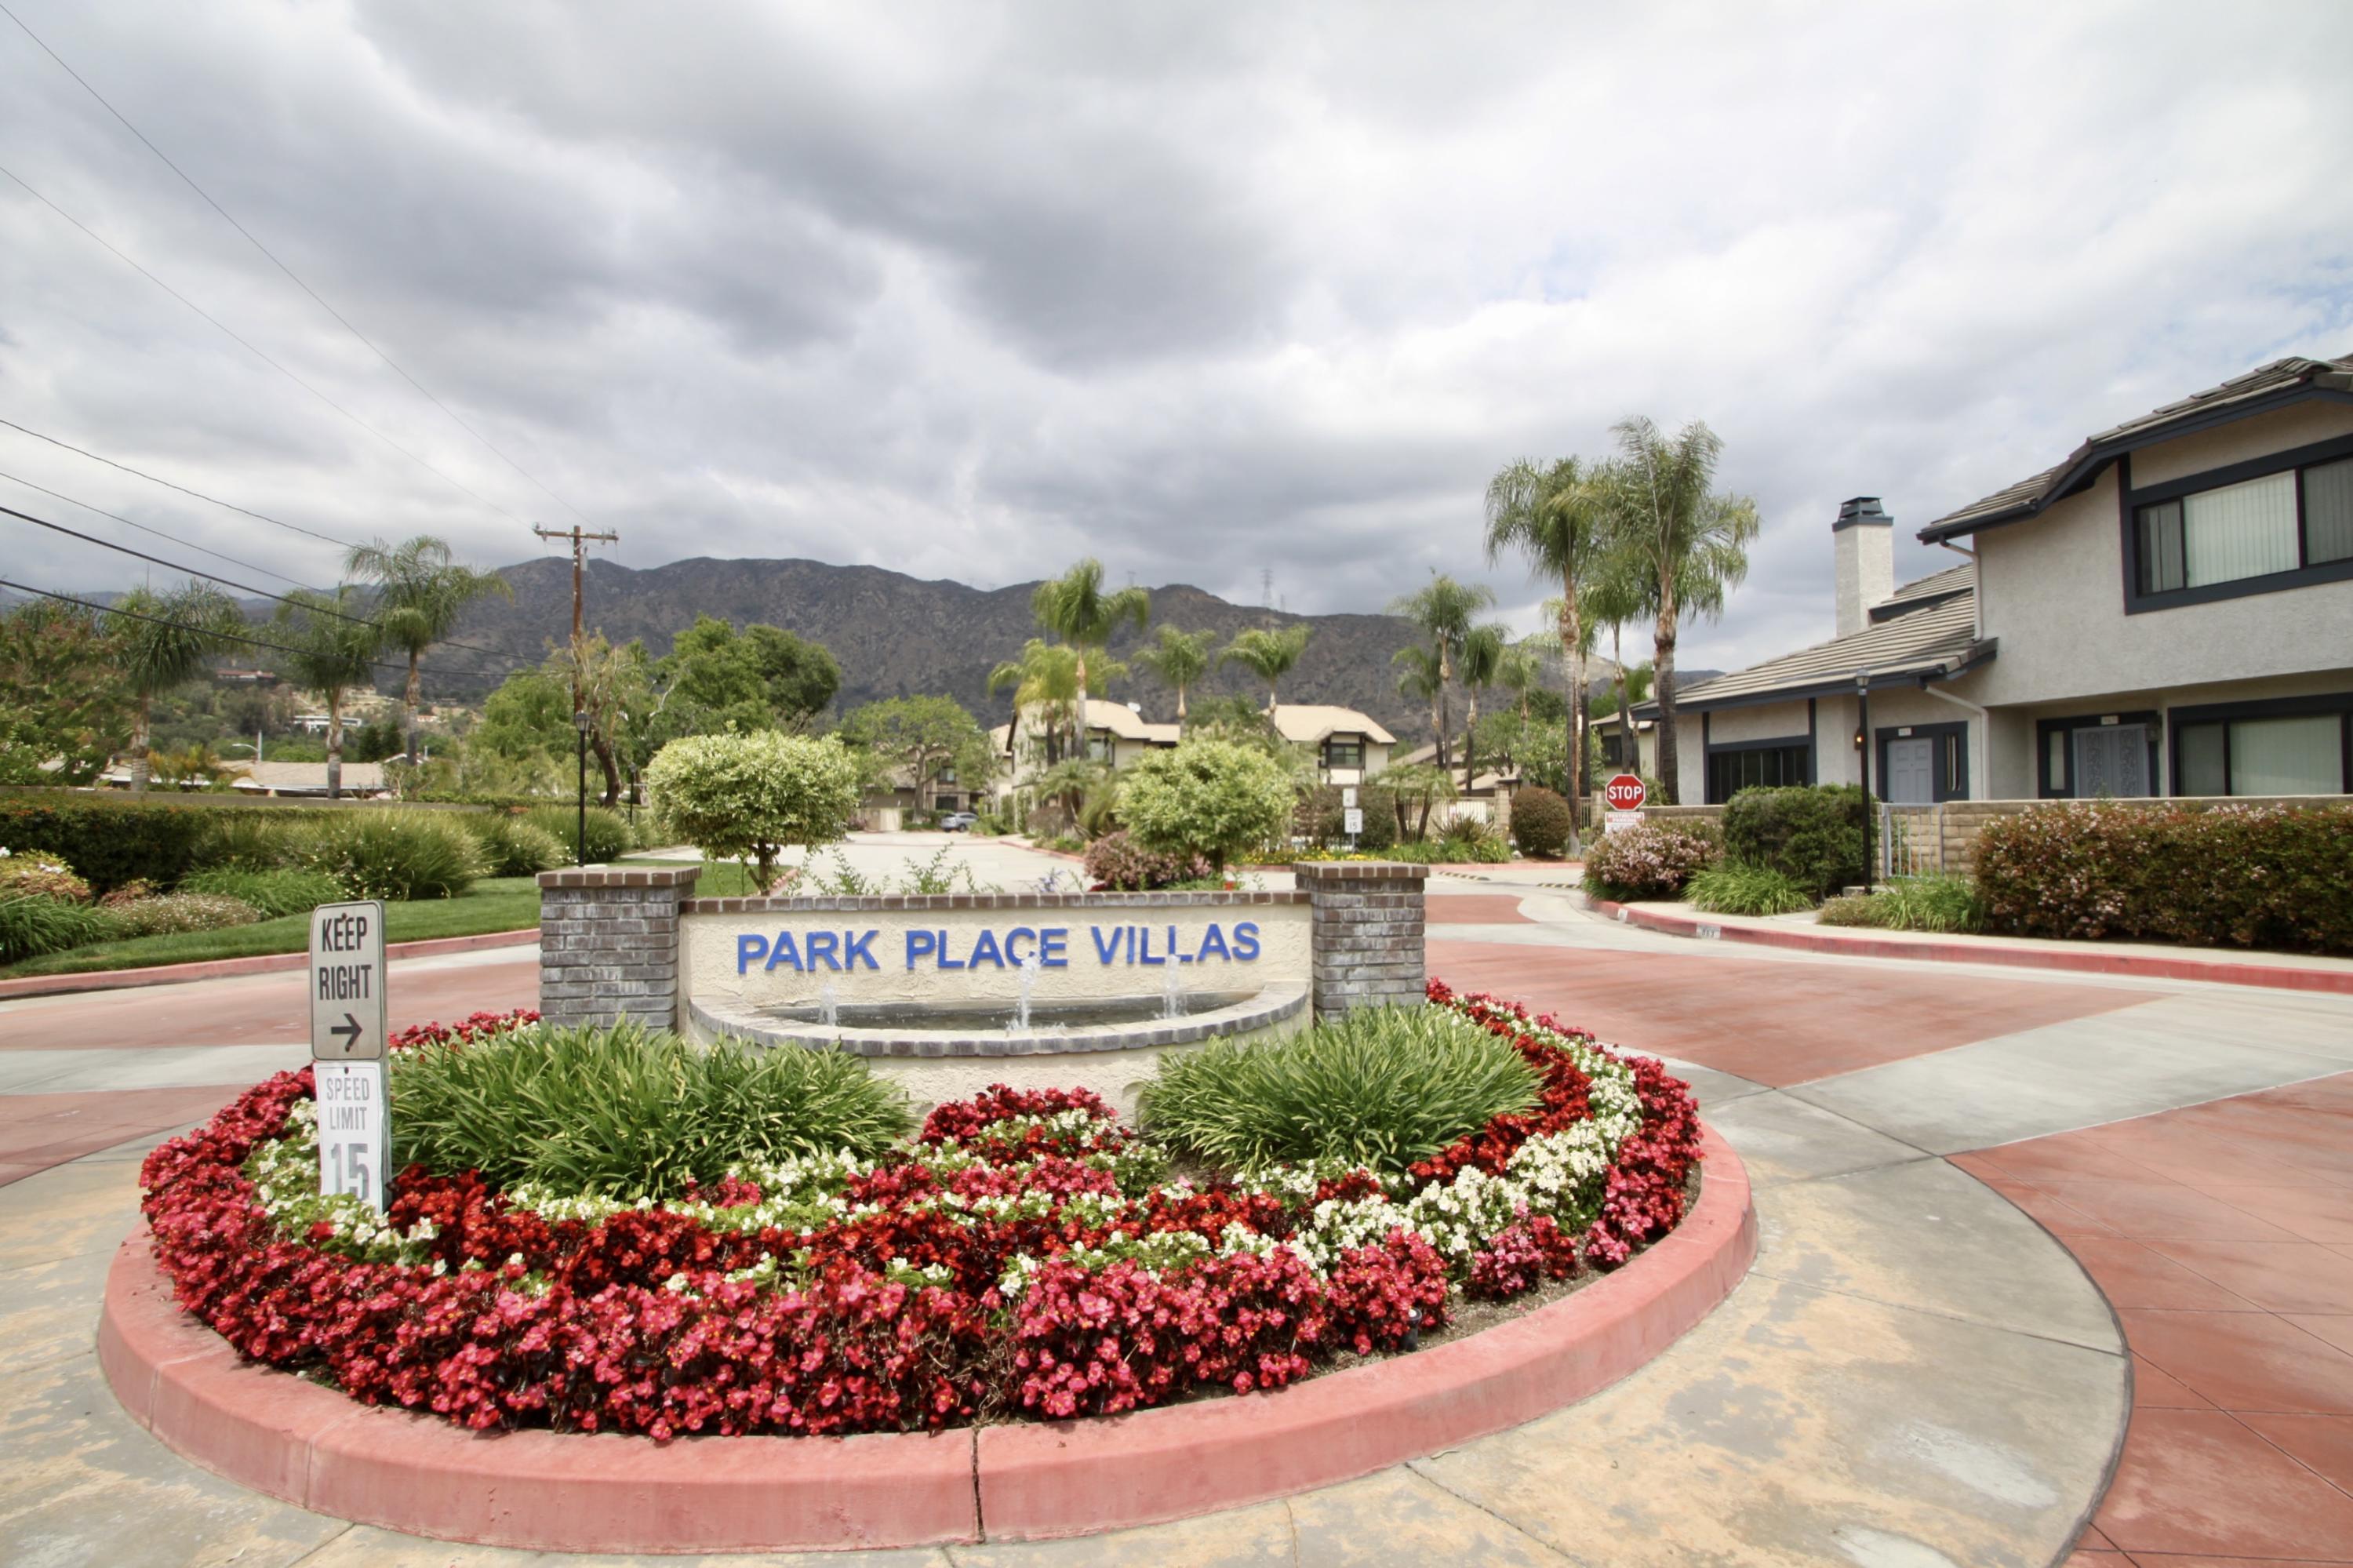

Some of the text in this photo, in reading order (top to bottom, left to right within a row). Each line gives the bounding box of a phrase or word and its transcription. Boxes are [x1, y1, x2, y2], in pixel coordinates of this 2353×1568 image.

[1608, 786, 1642, 799] STOP
[322, 916, 368, 952] KEEP
[736, 922, 1261, 974] PARK PLACE VILLAS
[318, 964, 372, 1001] RIGHT
[326, 1076, 370, 1101] SPEED
[329, 1106, 367, 1131] LIMIT
[330, 1143, 370, 1202] 15
